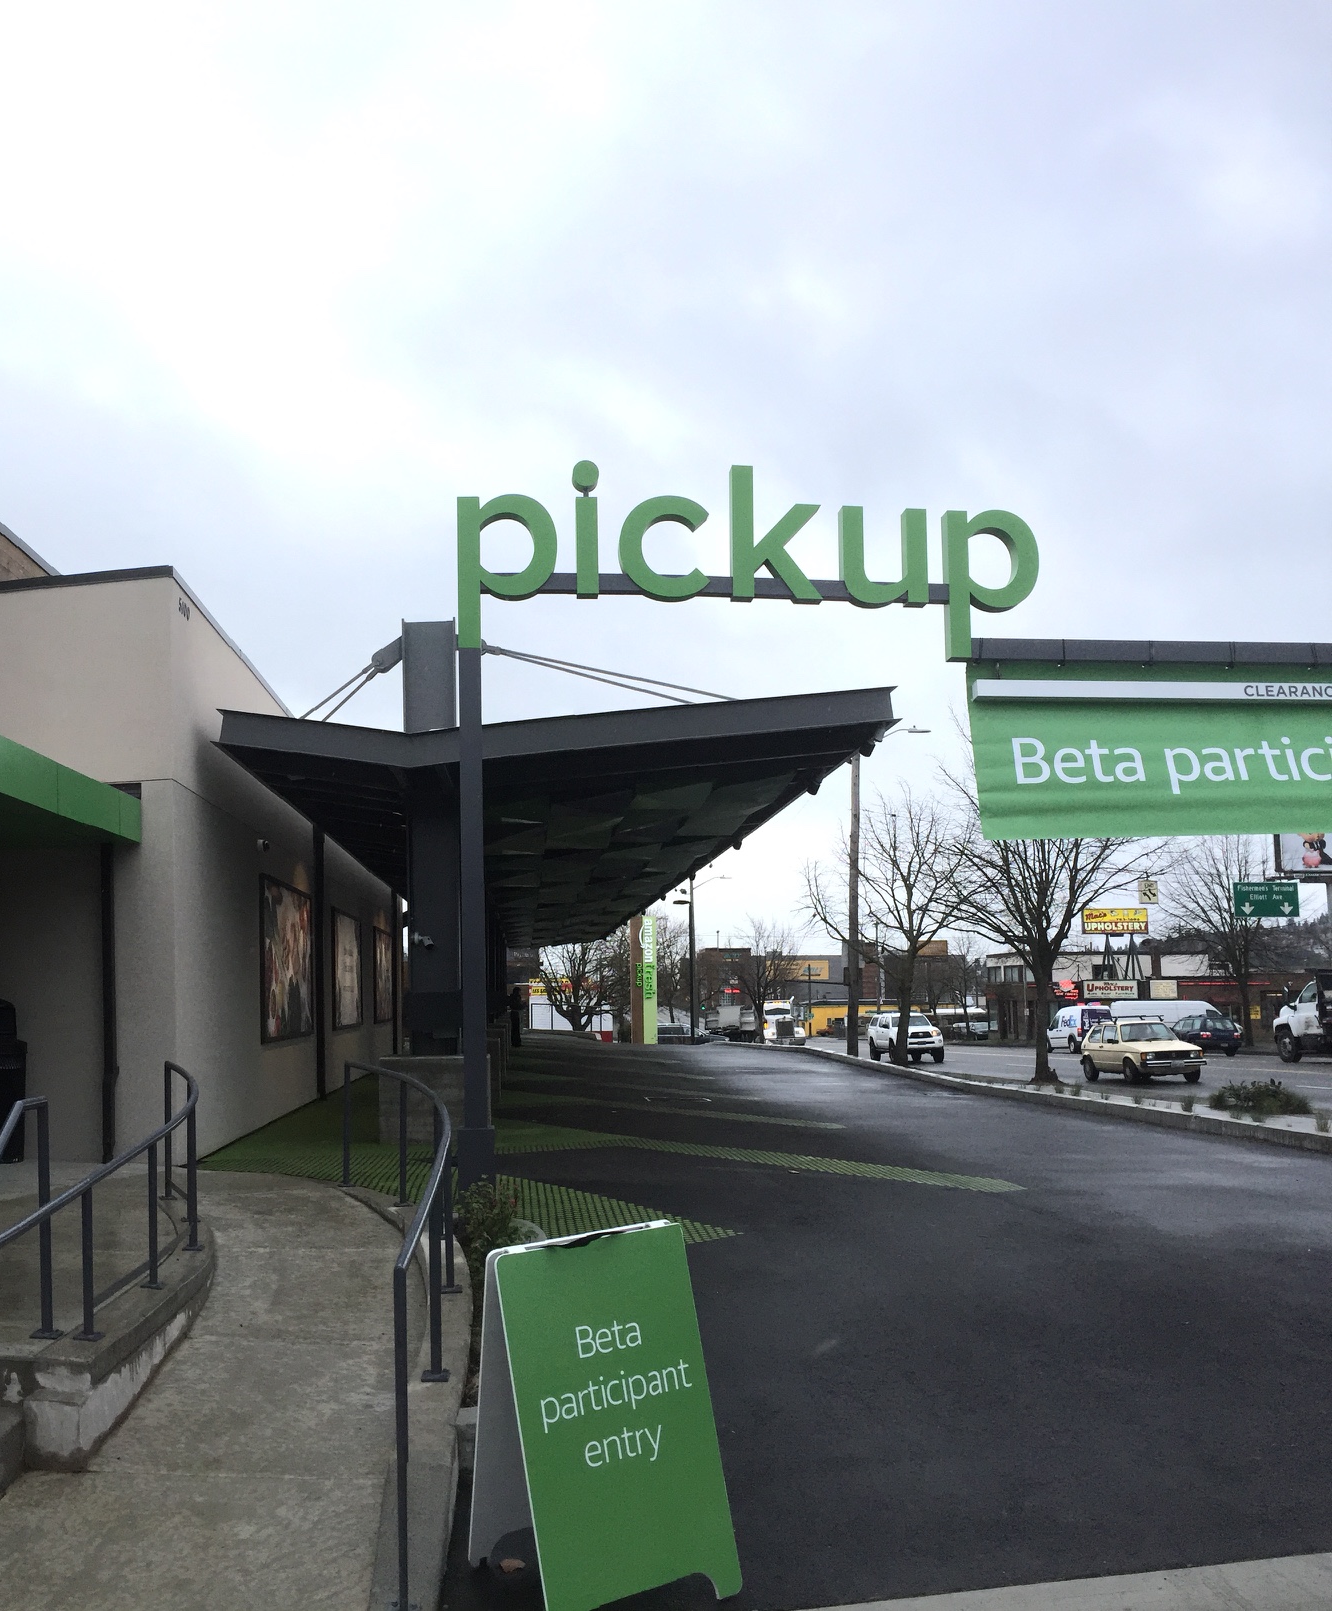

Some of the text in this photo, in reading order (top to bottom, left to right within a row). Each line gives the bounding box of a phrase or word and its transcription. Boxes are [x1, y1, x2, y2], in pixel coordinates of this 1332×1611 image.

[456, 460, 1039, 663] pickup
[1011, 737, 1146, 784] Beta
[1249, 893, 1283, 901] Elliott Ave
[1084, 922, 1147, 931] UPHOLSTERY
[635, 962, 643, 987] pickup
[1086, 983, 1134, 992] UPHOLSTERY
[1061, 1015, 1077, 1027] FedEx
[575, 1320, 642, 1359] Beta
[540, 1359, 693, 1434] participant
[584, 1425, 662, 1467] entry
